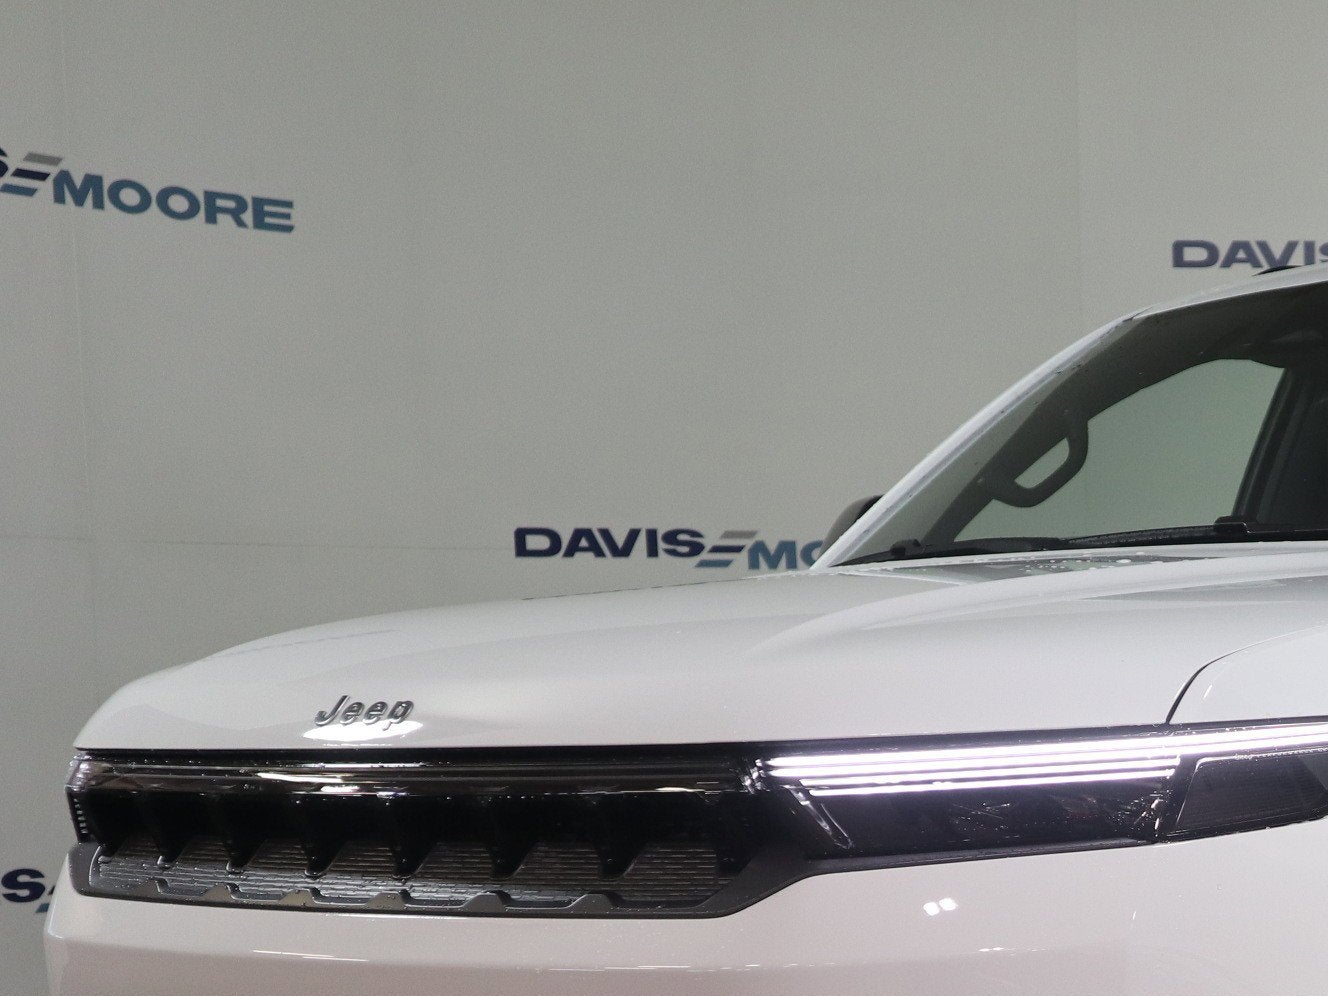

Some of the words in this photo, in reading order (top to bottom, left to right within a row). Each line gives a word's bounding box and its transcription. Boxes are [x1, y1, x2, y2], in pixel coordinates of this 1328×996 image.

[52, 168, 296, 234] MOORE
[513, 527, 706, 558] DAVIS
[314, 694, 415, 731] Jeep
